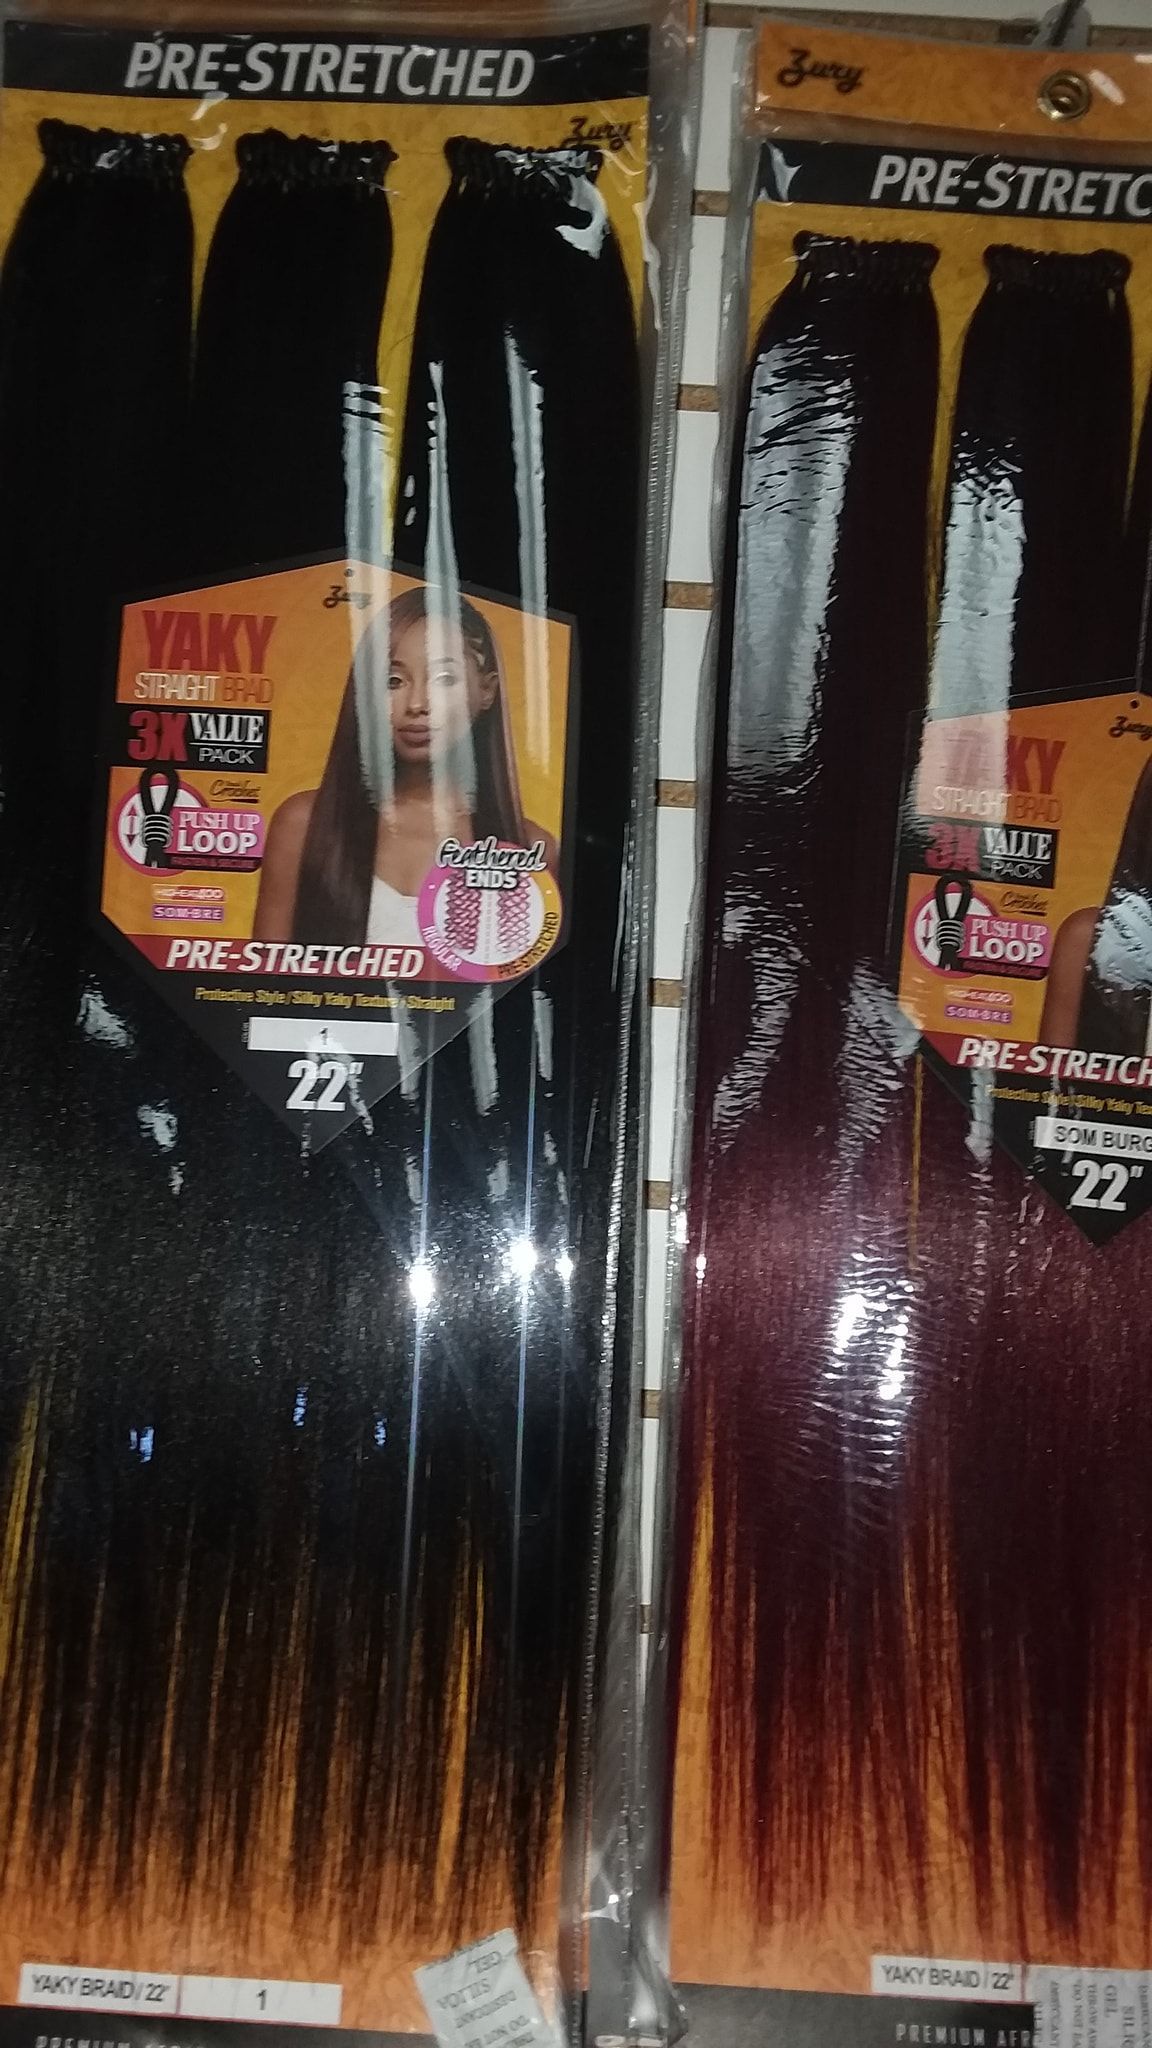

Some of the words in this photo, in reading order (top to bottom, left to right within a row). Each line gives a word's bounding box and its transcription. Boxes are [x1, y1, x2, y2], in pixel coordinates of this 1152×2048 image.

[124, 41, 535, 98] PRE-STRETCHED
[870, 154, 1152, 217] PRE-STRETC
[143, 610, 278, 674] YAKY
[134, 671, 221, 701] STRAIGHT
[221, 677, 274, 704] BRAID
[127, 710, 188, 762] 3X
[189, 713, 264, 743] VALUE
[199, 747, 255, 764] PACK
[178, 810, 230, 830] PUSH
[233, 813, 260, 831] UP
[176, 829, 258, 854] LOOP
[436, 835, 547, 871] Feathered
[982, 826, 1053, 860] VALUE
[466, 869, 518, 889] ENDS
[990, 860, 1044, 880] PACK
[970, 918, 1018, 939] PUSH
[1021, 923, 1048, 942] UP
[165, 939, 425, 978] PRE-STRETCHED
[969, 935, 1044, 964] LOOP
[320, 1028, 329, 1046] 1
[286, 1059, 364, 1111] 22"
[1055, 1125, 1096, 1146] SOM
[1102, 1130, 1152, 1153] BURG
[1070, 1159, 1144, 1211] 22"
[32, 1974, 78, 1994] YAKY
[80, 1977, 135, 1999] BRAID
[881, 1964, 925, 1985] YAKY
[929, 1968, 981, 1988] BRAID
[256, 1989, 267, 2010] 1
[895, 2023, 985, 2046] PREMIUM
